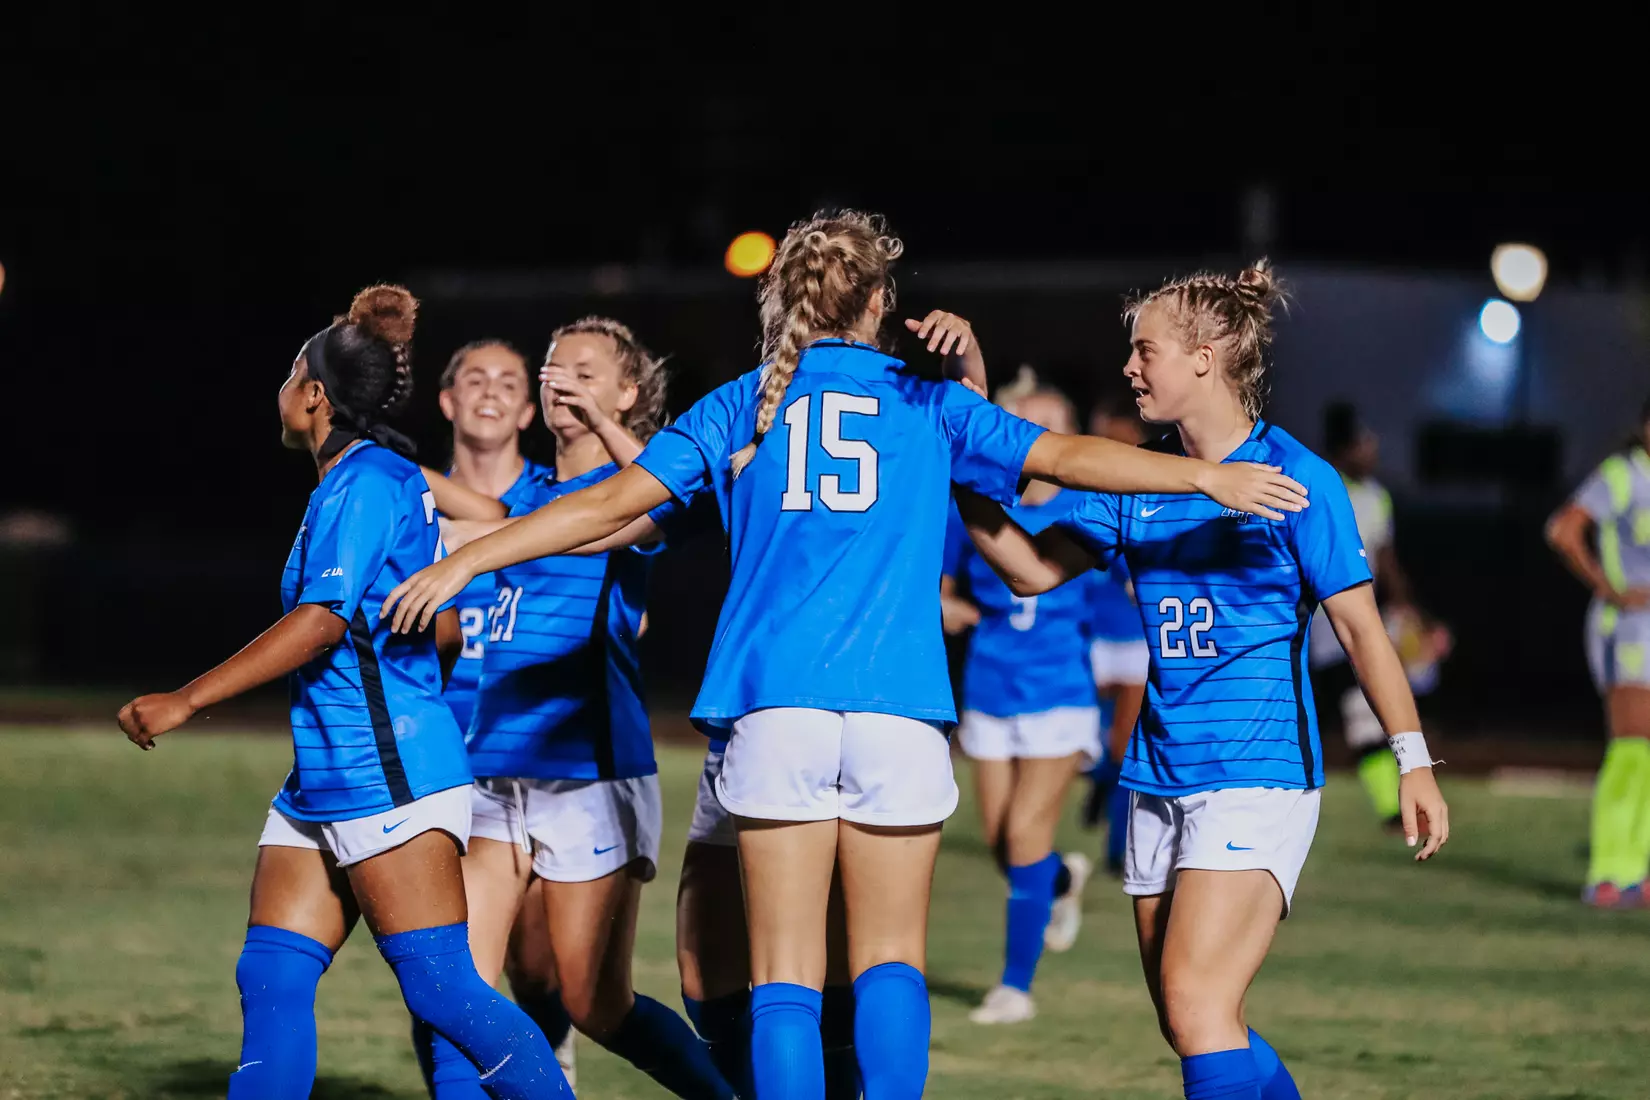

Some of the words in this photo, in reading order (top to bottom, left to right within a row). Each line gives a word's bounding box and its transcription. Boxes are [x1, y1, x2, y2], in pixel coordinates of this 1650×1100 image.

[780, 390, 880, 512] 15
[487, 586, 523, 642] 21
[1158, 596, 1219, 658] 22
